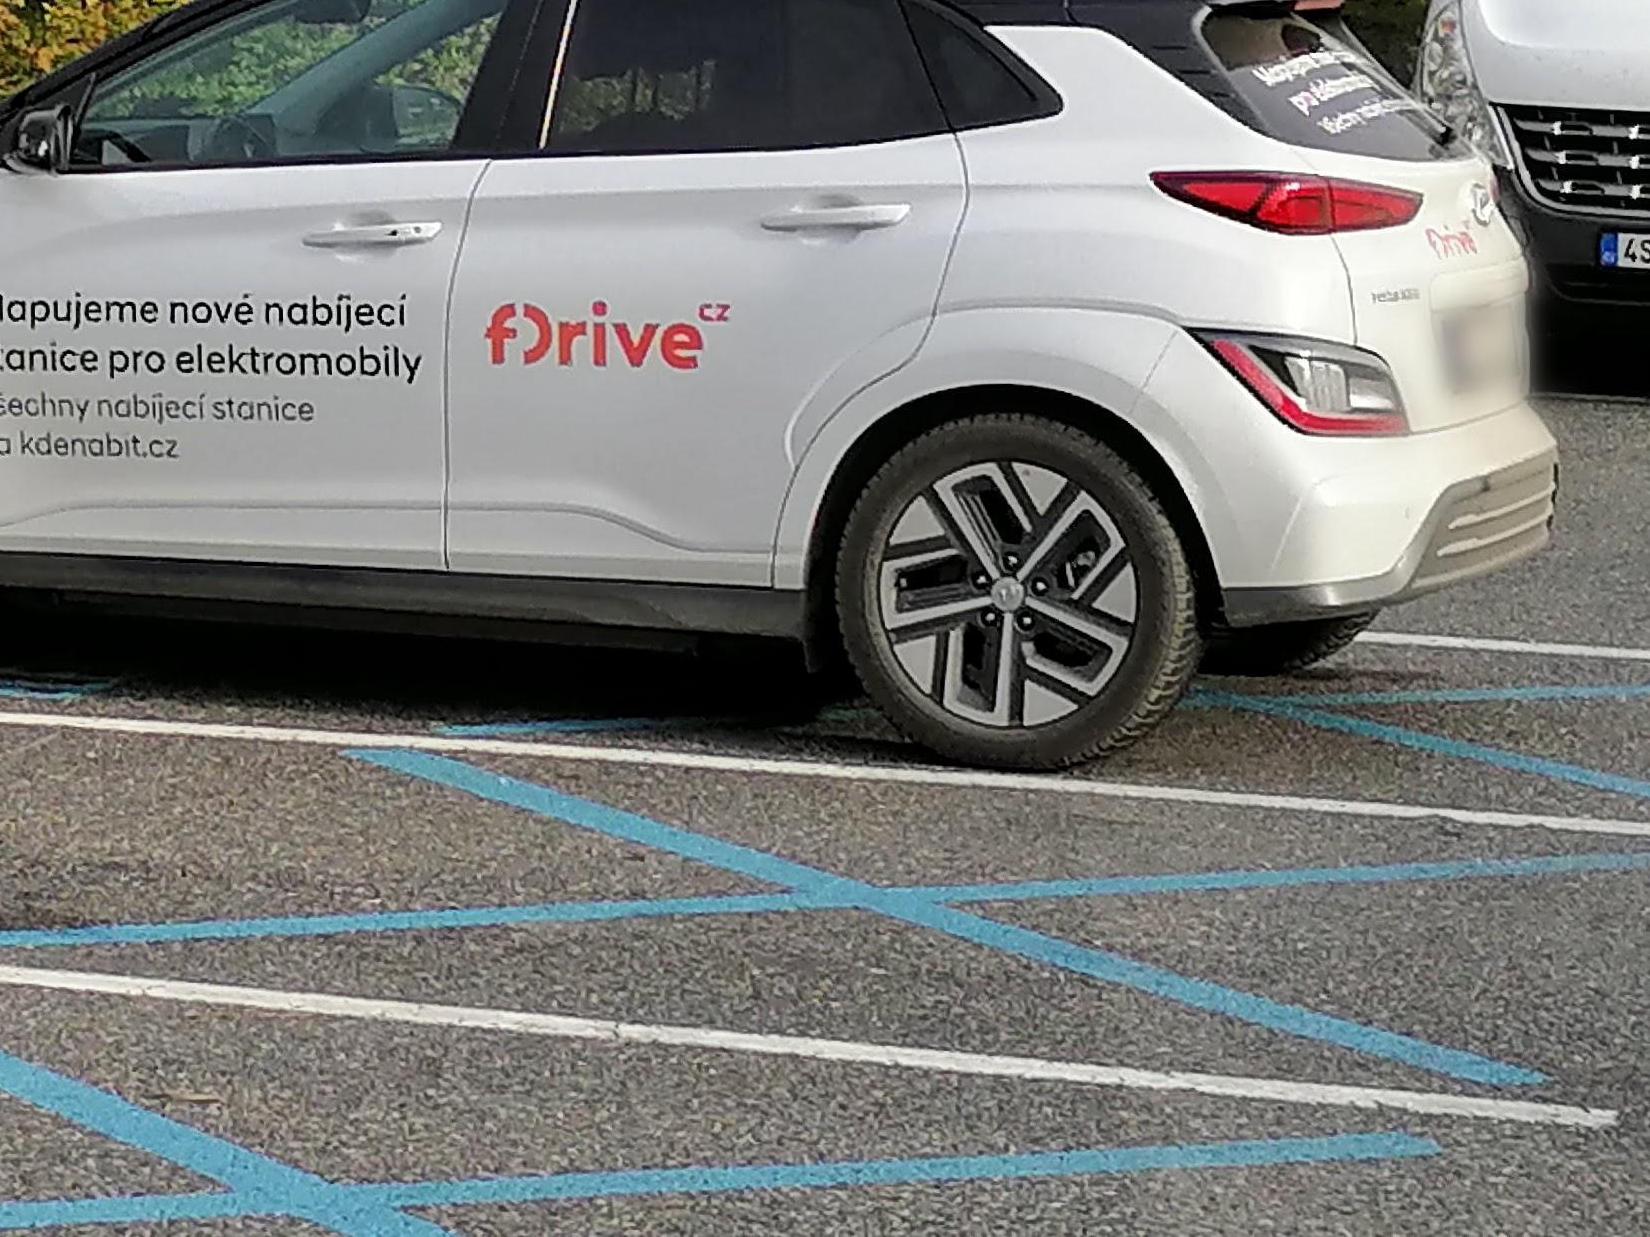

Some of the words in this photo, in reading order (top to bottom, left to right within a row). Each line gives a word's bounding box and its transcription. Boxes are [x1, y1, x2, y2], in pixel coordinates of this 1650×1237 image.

[170, 293, 254, 326] nové
[264, 293, 407, 334] nabíjecí
[109, 350, 166, 379] pro
[176, 343, 422, 384] elektromobily
[97, 392, 205, 425] nabíjecí
[212, 395, 315, 422] stanice
[20, 430, 179, 459] kdenabit.cz
